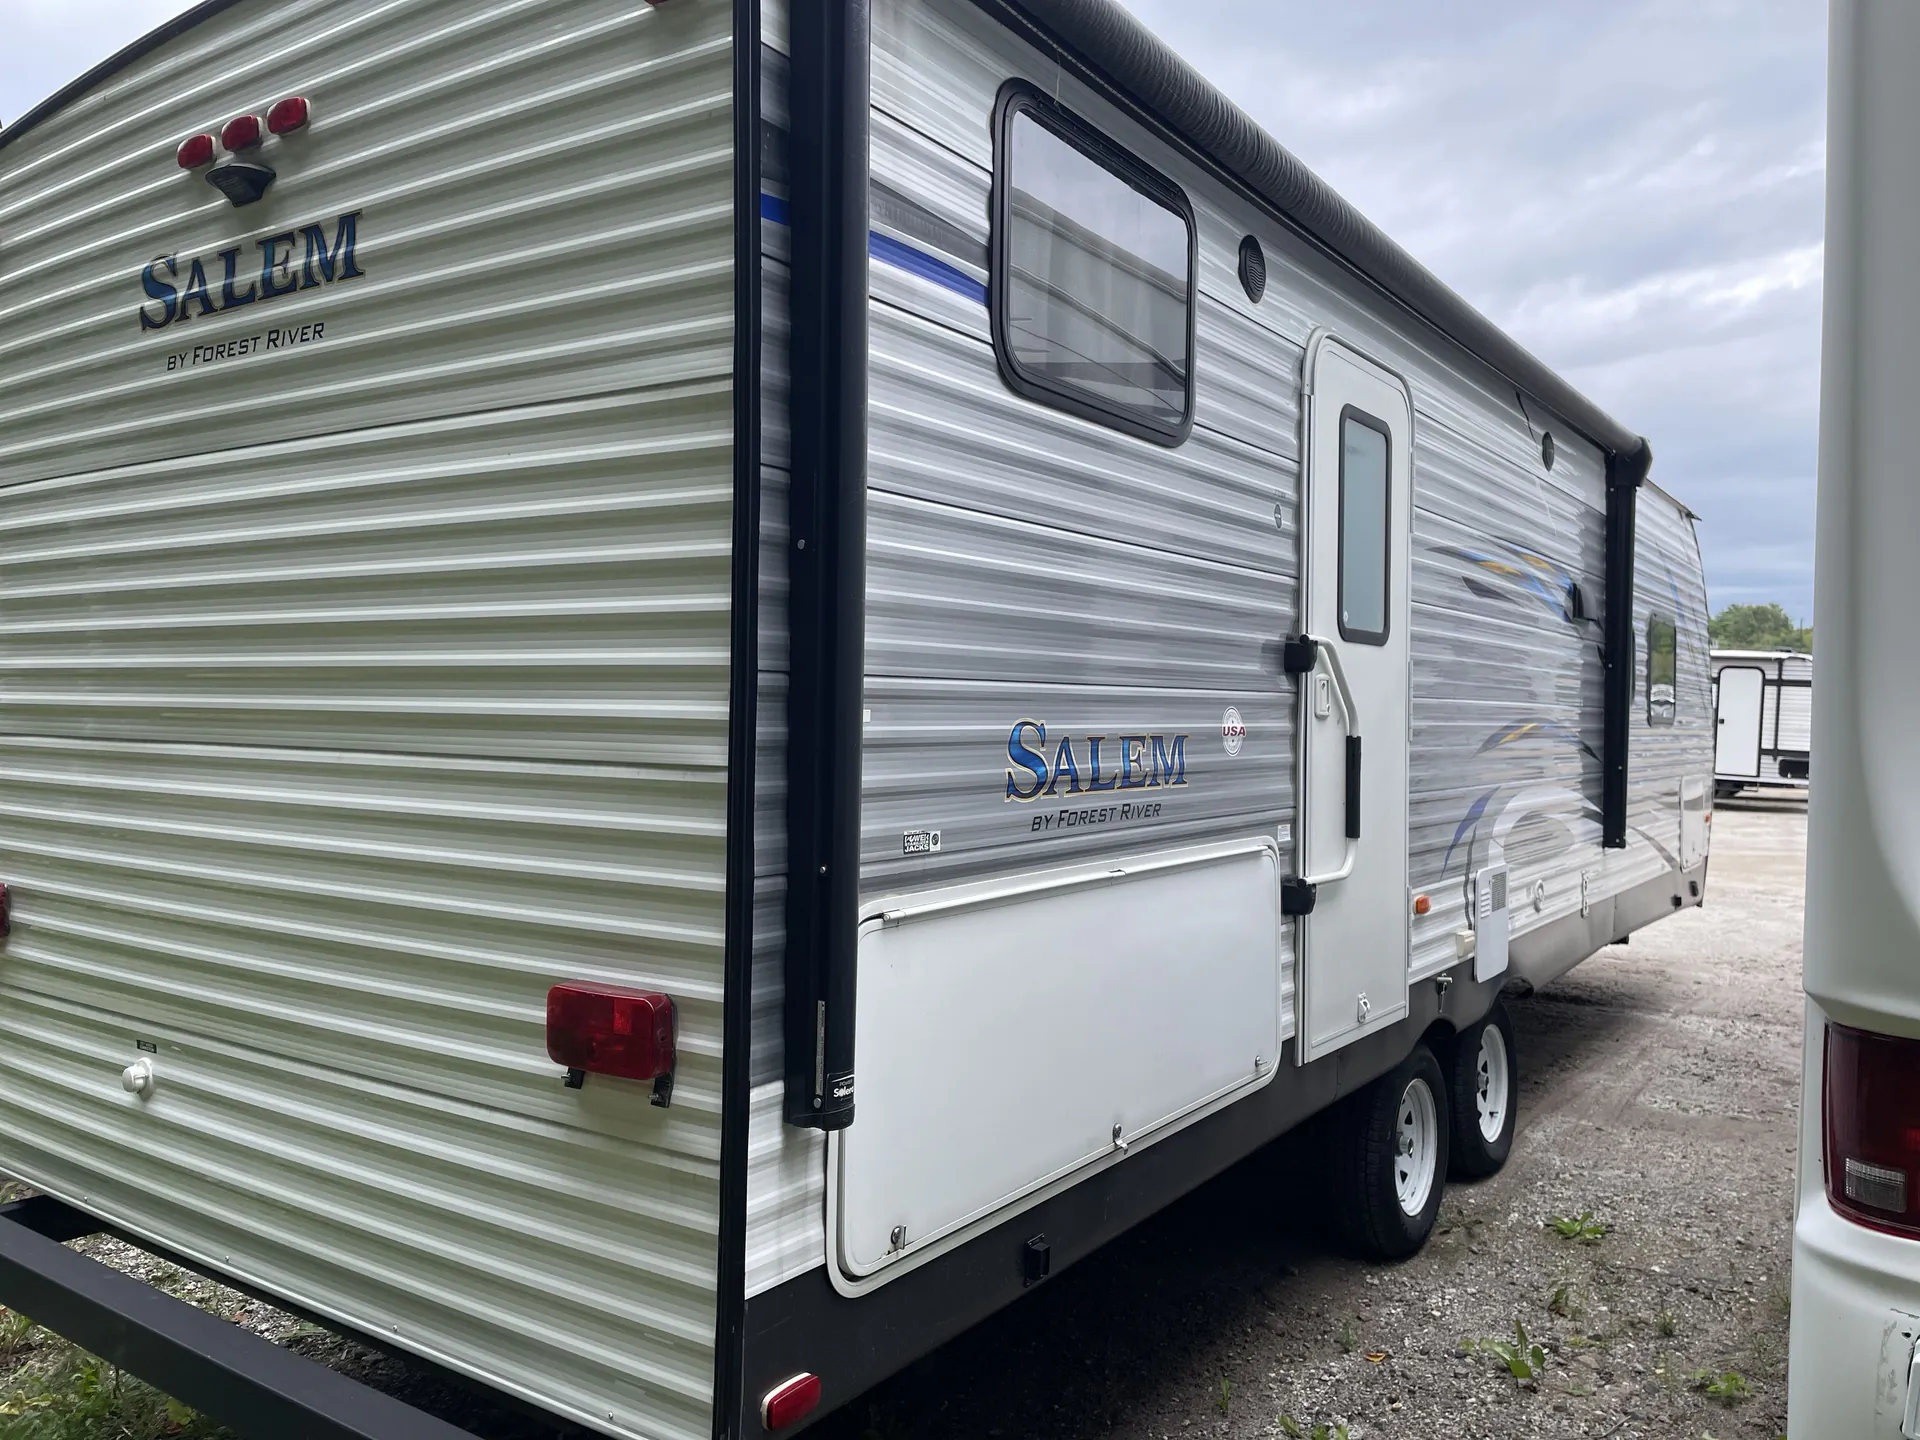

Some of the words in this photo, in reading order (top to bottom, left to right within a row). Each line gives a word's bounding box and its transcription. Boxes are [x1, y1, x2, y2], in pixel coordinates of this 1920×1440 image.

[139, 209, 366, 332] SALEM
[167, 353, 188, 371] BY
[192, 336, 261, 364] FOREST
[266, 323, 325, 349] RIVER
[1222, 726, 1246, 736] USA
[1005, 718, 1189, 802] SALEM
[1031, 814, 1053, 832] BY
[1057, 807, 1117, 828] FOREST
[1119, 803, 1162, 821] RIVER
[905, 834, 929, 842] POWER
[905, 844, 928, 852] JACKS
